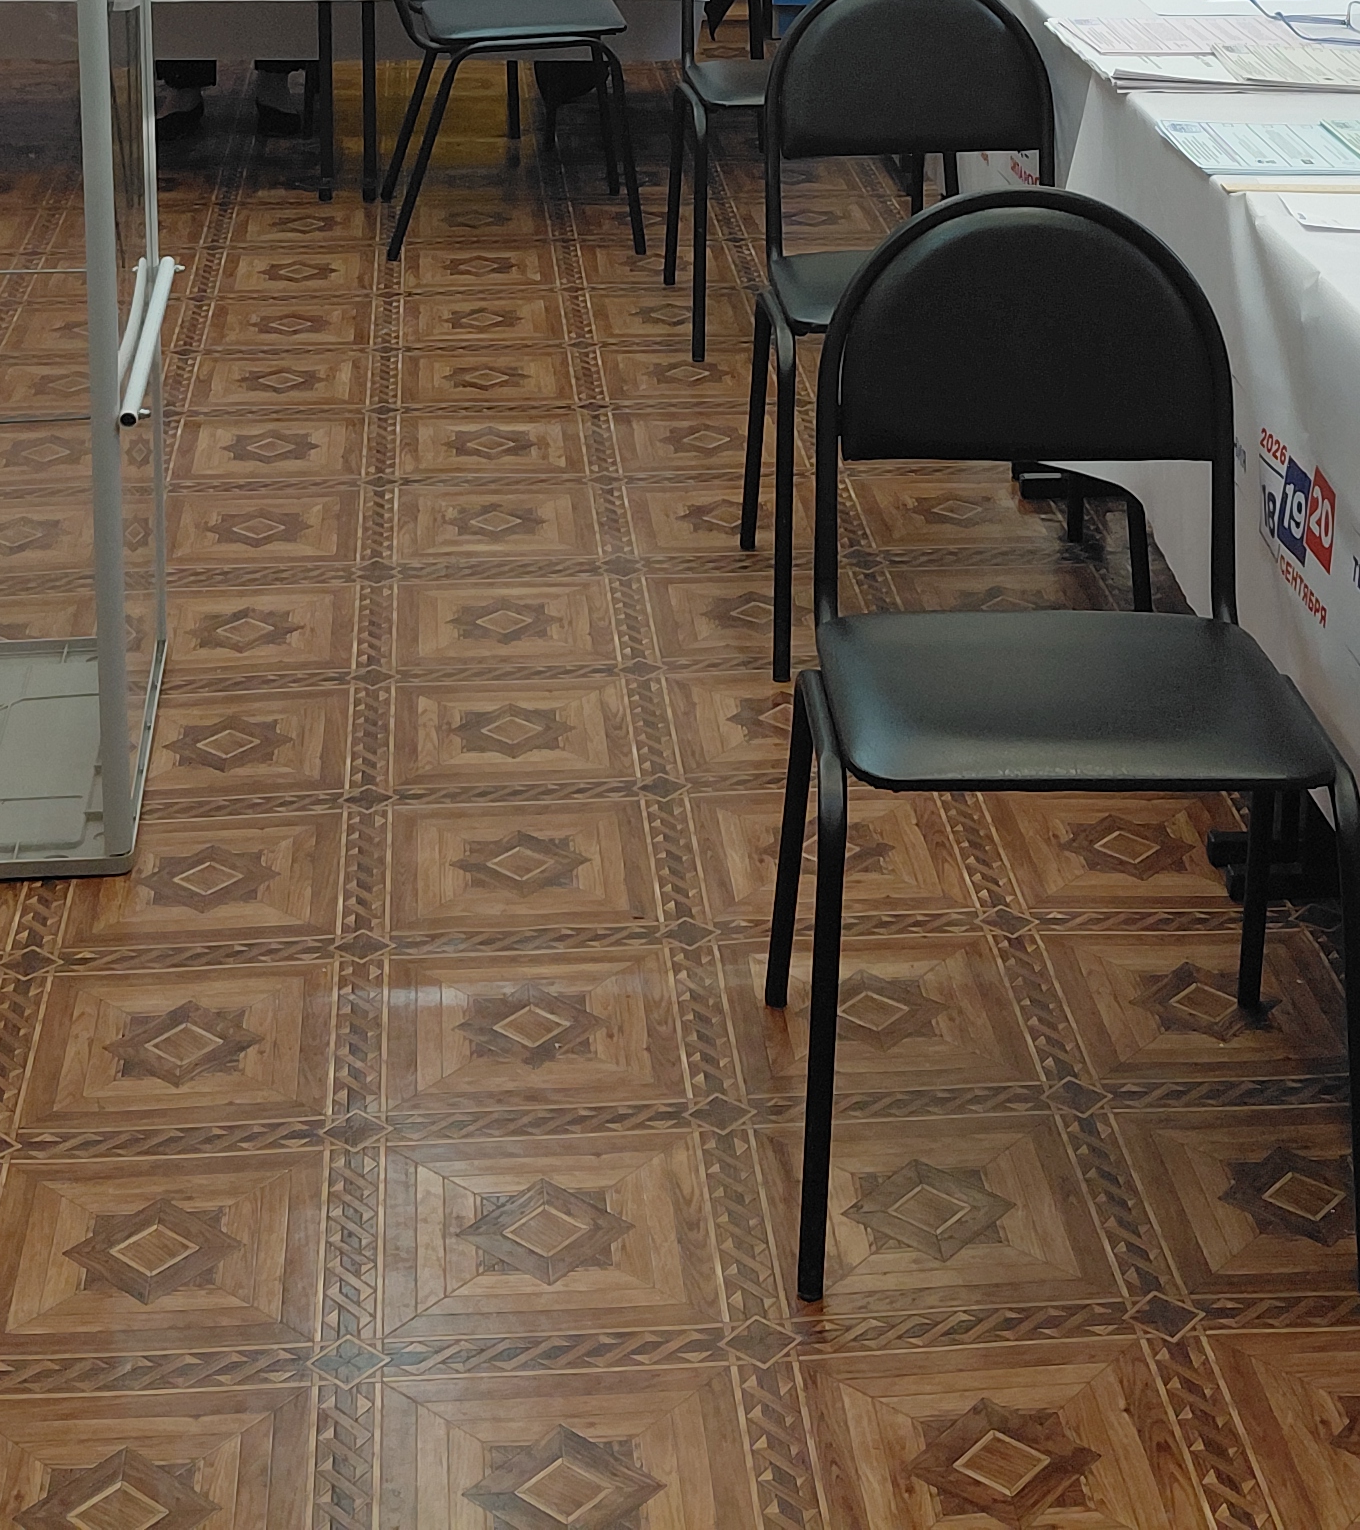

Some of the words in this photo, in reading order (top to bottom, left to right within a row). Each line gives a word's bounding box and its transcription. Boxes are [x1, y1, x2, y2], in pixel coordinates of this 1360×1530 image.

[1259, 427, 1288, 466] 2026
[1262, 484, 1276, 539] 18
[1282, 483, 1306, 540] 19
[1309, 485, 1333, 548] 20
[1279, 554, 1328, 628] СЕНТЯБРЯ
